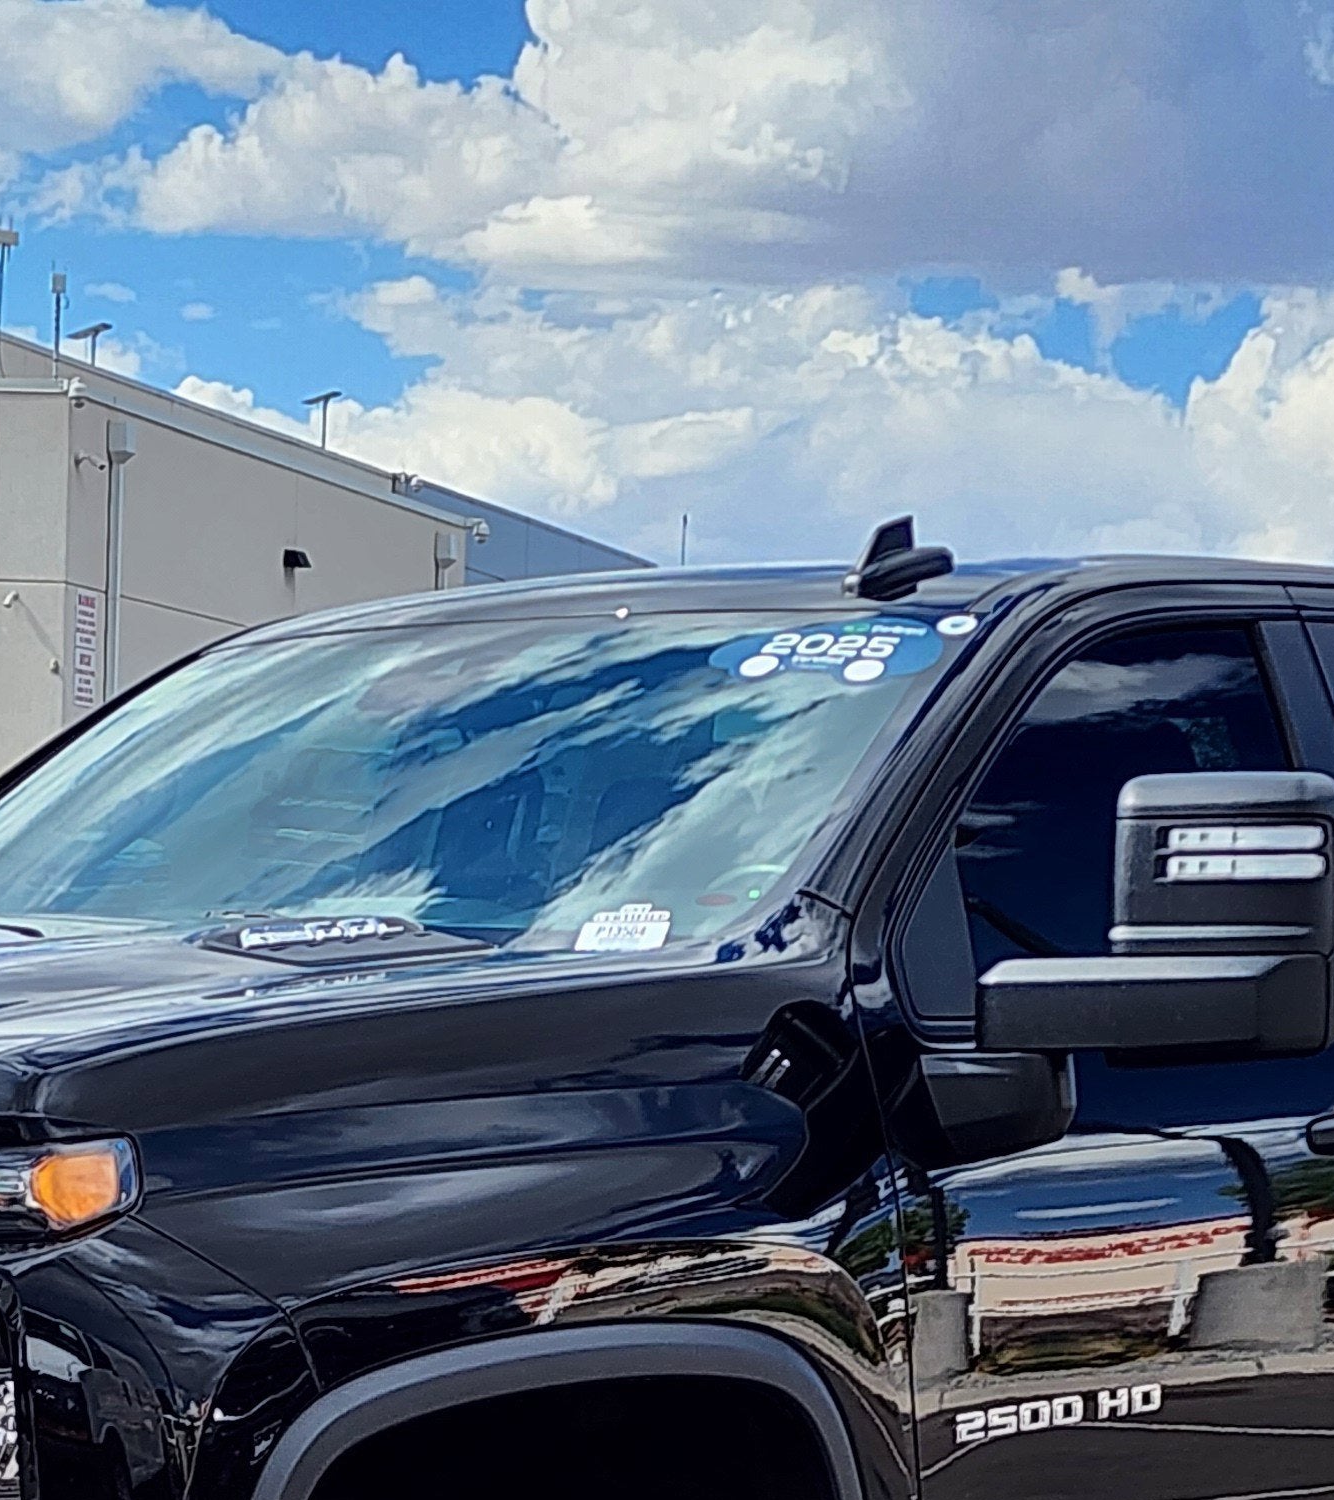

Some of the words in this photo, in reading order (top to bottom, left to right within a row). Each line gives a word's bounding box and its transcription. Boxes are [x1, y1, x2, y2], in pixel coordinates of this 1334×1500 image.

[760, 632, 902, 659] 2025
[954, 1394, 1084, 1445] 2500
[1097, 1382, 1163, 1421] HD
